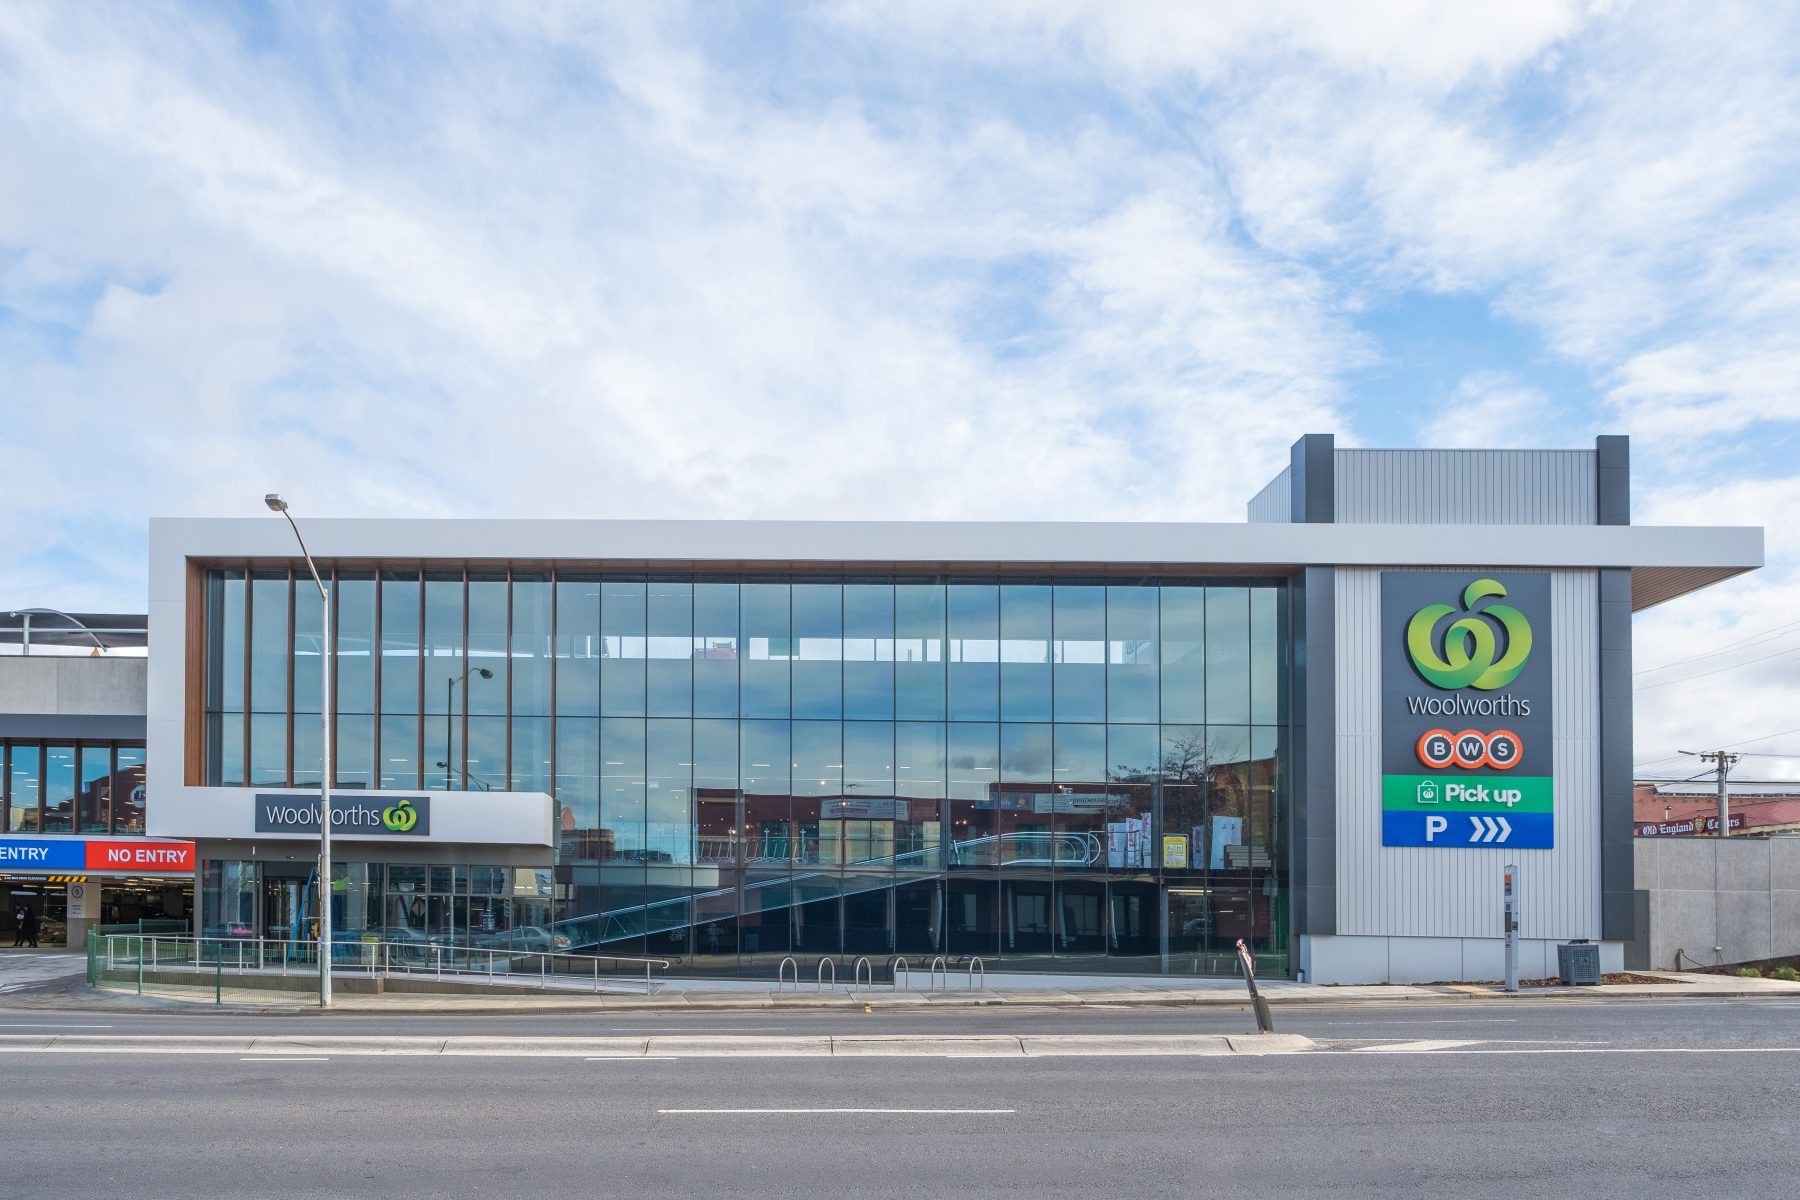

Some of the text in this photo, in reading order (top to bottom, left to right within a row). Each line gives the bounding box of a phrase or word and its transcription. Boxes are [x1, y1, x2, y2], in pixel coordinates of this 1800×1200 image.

[1408, 693, 1531, 716] Woolworths
[1445, 784, 1522, 807] Pick up
[1426, 815, 1448, 842] P
[1642, 818, 1740, 836] Old England Cers
[0, 847, 48, 861] ENTRY
[108, 848, 188, 863] NO ENTRY
